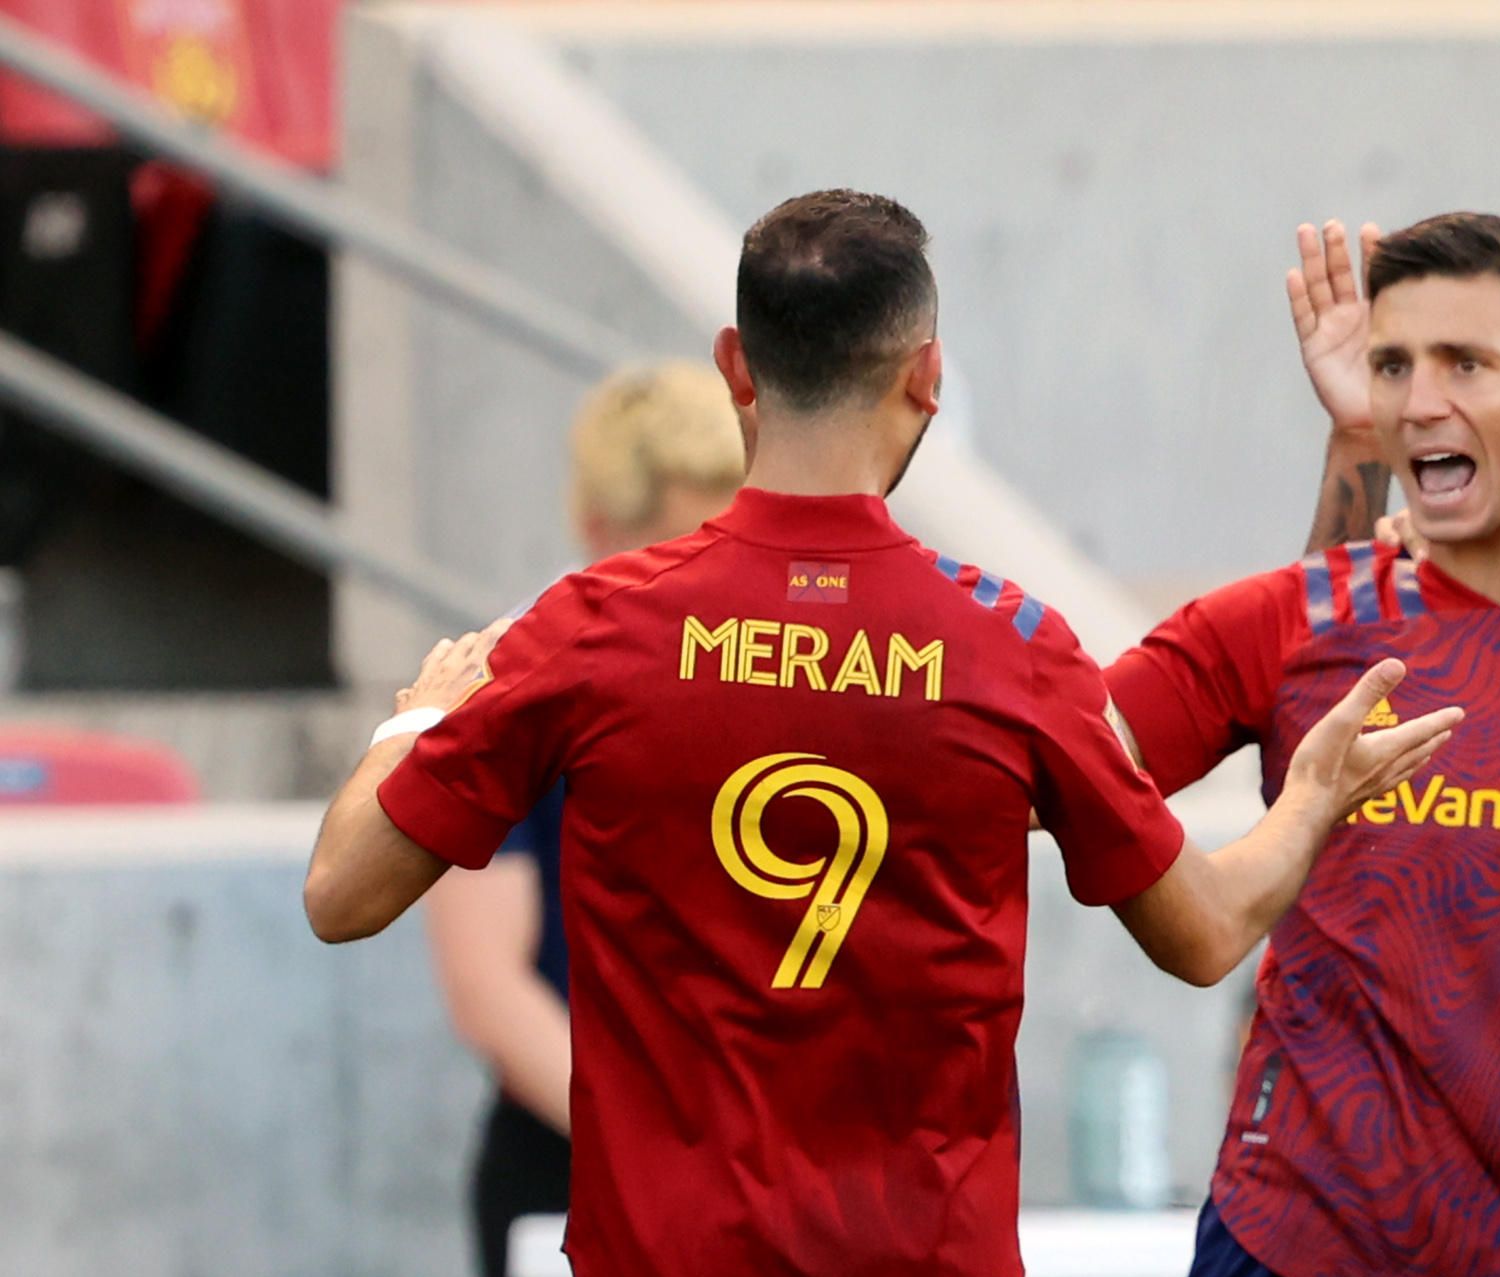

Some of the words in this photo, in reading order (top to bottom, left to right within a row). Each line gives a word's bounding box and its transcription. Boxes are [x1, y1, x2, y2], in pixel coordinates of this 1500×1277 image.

[789, 574, 808, 588] AS
[816, 575, 848, 589] ONE
[679, 615, 945, 702] MERAM
[711, 752, 889, 989] 9
